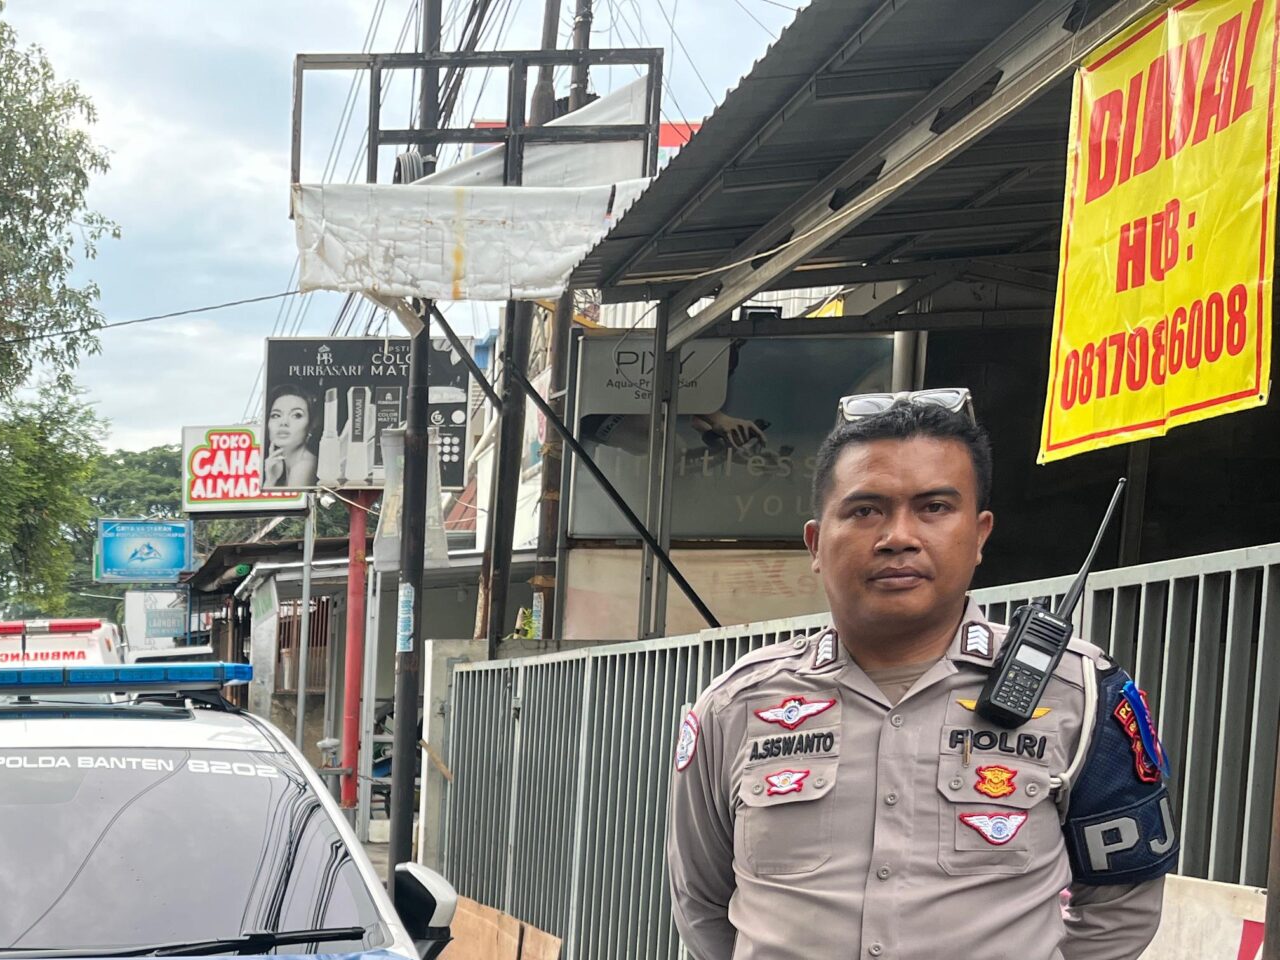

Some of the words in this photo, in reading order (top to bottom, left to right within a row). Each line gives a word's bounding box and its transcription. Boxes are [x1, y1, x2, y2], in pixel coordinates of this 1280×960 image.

[1084, 0, 1263, 205] DIJUAL
[210, 434, 251, 450] TOKO
[191, 449, 260, 477] CAHA
[949, 729, 1047, 760] POLRI
[77, 756, 175, 772] BANTEN
[186, 760, 279, 779] 8202
